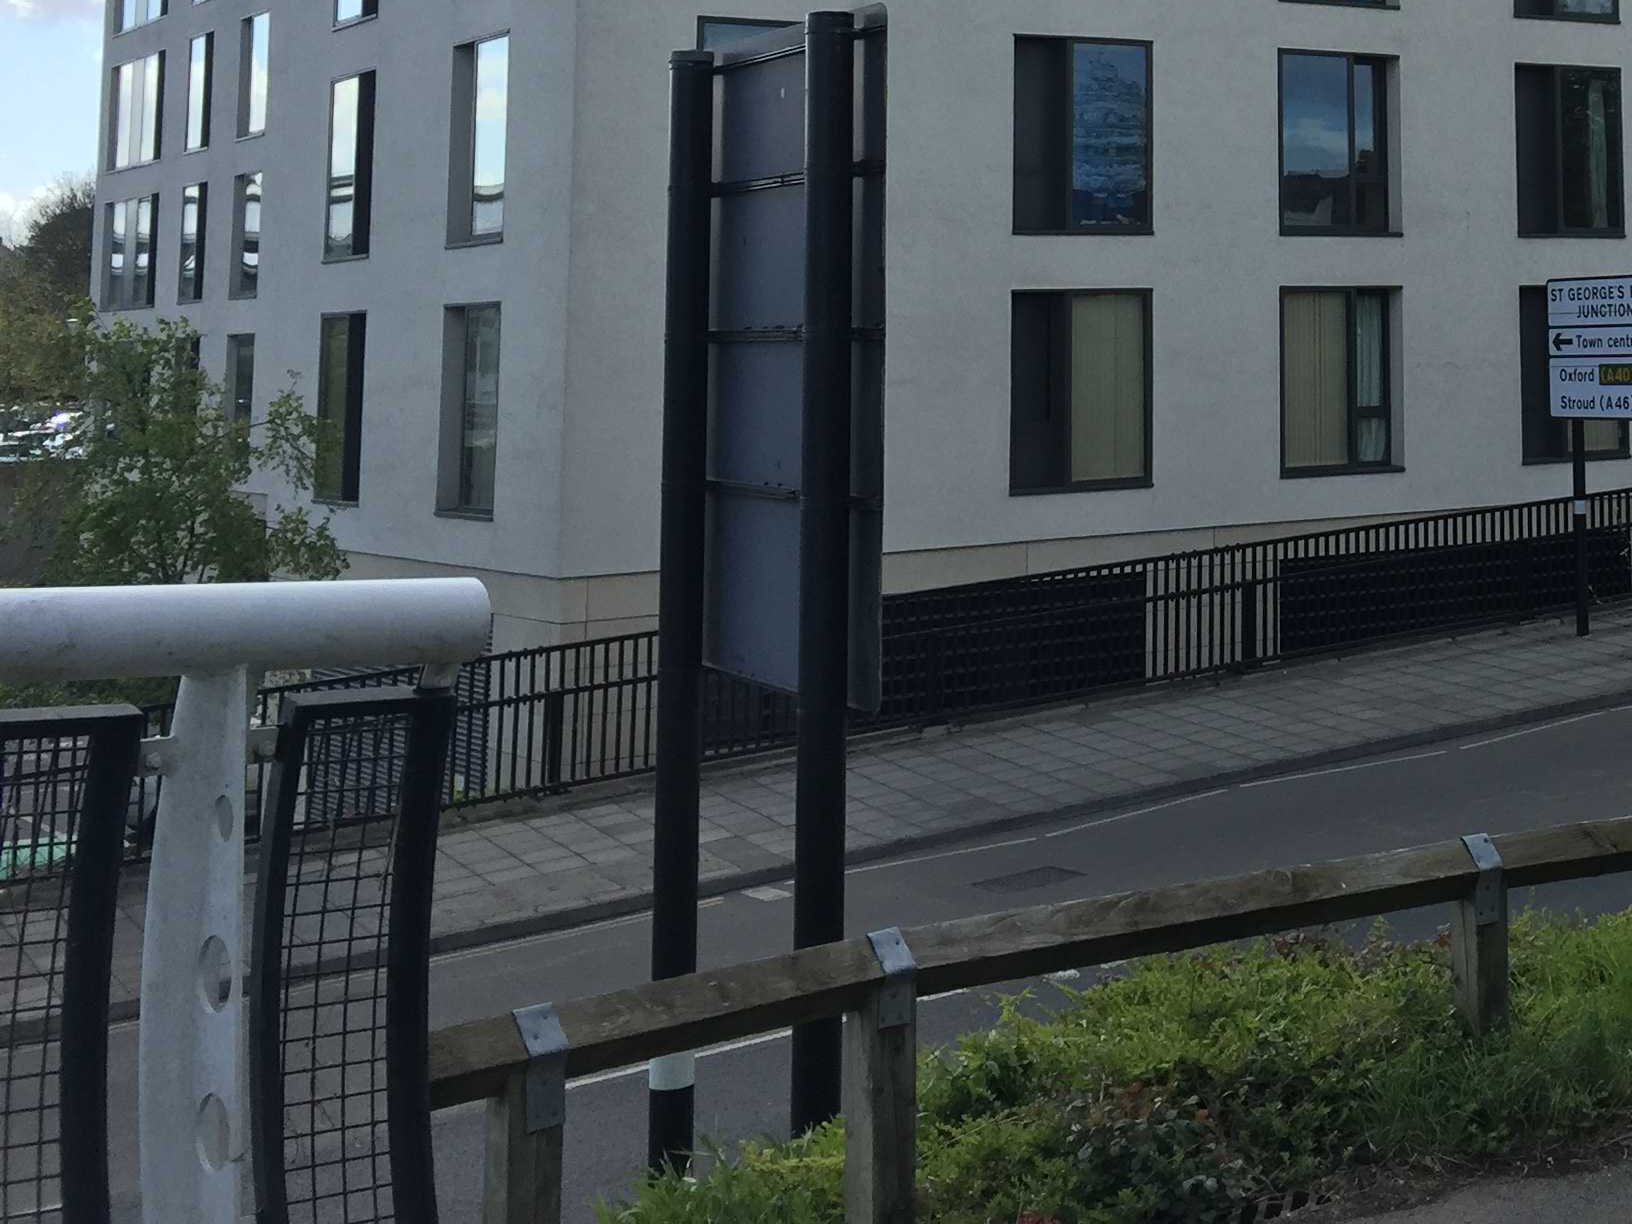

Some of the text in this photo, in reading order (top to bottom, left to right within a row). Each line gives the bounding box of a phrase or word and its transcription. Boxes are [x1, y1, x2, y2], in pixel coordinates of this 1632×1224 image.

[1550, 288, 1563, 302] ST
[1568, 286, 1625, 301] GEORGE'S
[1576, 335, 1603, 348] Town
[1559, 369, 1595, 382] Oxford
[1561, 395, 1595, 409] Stroud
